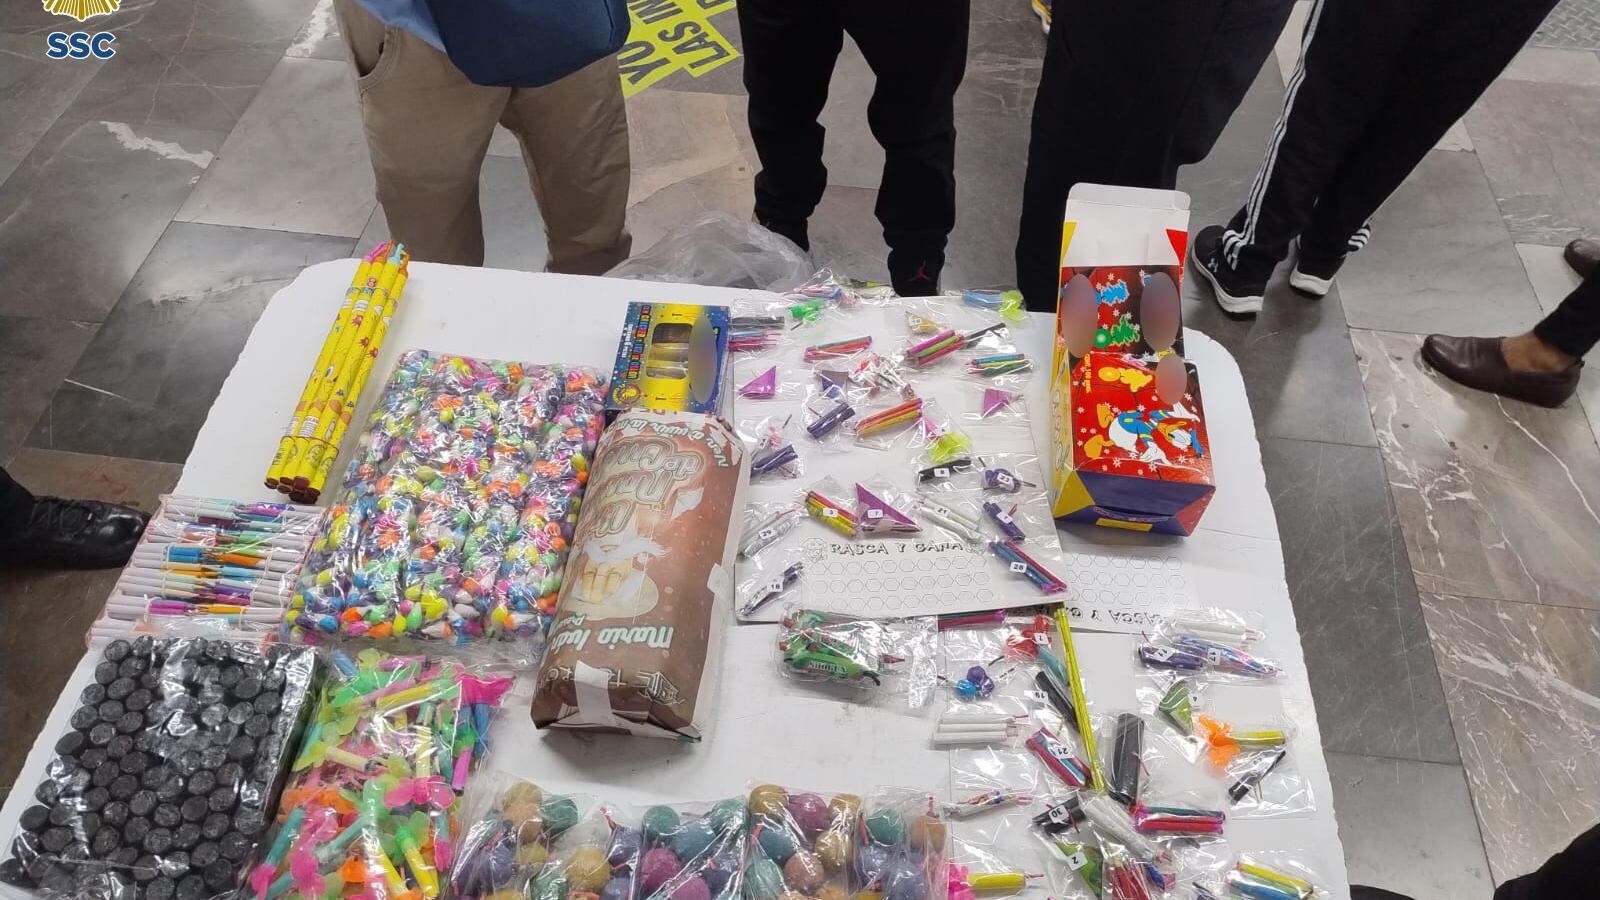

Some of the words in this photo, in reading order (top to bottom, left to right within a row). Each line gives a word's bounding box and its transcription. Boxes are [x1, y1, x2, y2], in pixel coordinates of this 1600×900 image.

[628, 0, 683, 24] IN
[658, 21, 730, 69] LAS
[761, 529, 772, 537] 29
[831, 543, 889, 556] RASCA
[898, 543, 907, 553] Y
[915, 541, 964, 553] GANA
[1013, 563, 1024, 571] 28
[1091, 609, 1101, 621] Y
[597, 626, 675, 650] Mario
[1209, 651, 1217, 662] 17
[1058, 746, 1069, 755] 21
[1052, 810, 1063, 819] 30
[1072, 856, 1079, 865] 2
